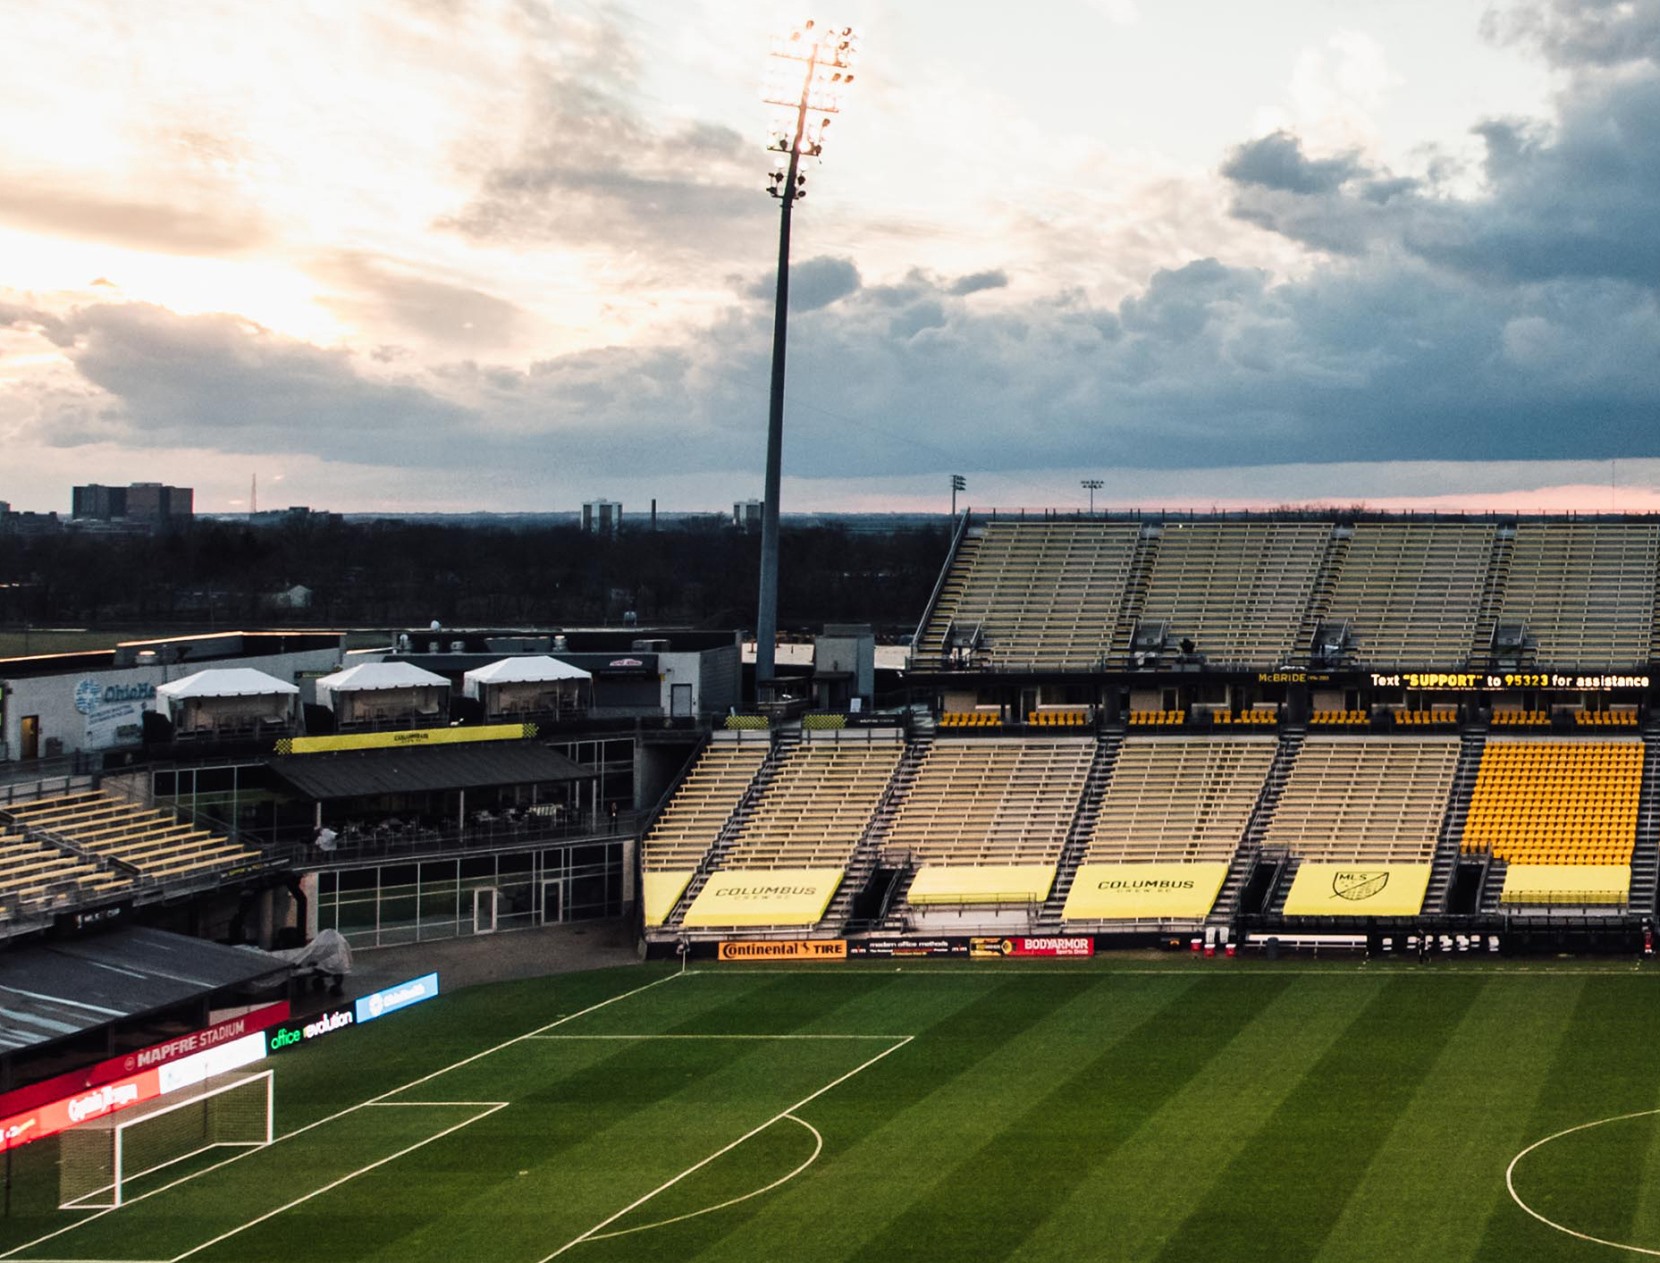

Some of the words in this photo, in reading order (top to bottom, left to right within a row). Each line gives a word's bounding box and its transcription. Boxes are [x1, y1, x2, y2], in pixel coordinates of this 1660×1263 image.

[1258, 673, 1307, 683] McBRIDE
[1370, 674, 1400, 686] Text
[1487, 675, 1502, 687] to
[1504, 674, 1549, 686] 95323
[1552, 674, 1573, 687] for
[1576, 675, 1650, 687] assistance
[1097, 880, 1195, 890] COLUMBUS
[715, 886, 817, 897] COLUMBUS
[1024, 938, 1089, 950] BODYARMOR
[722, 942, 799, 959] Continental
[813, 945, 842, 955] TIRE
[270, 1027, 301, 1050] office
[302, 1010, 353, 1039] revolution
[137, 1035, 198, 1068] MAPFRE
[199, 1019, 245, 1047] STADIUM
